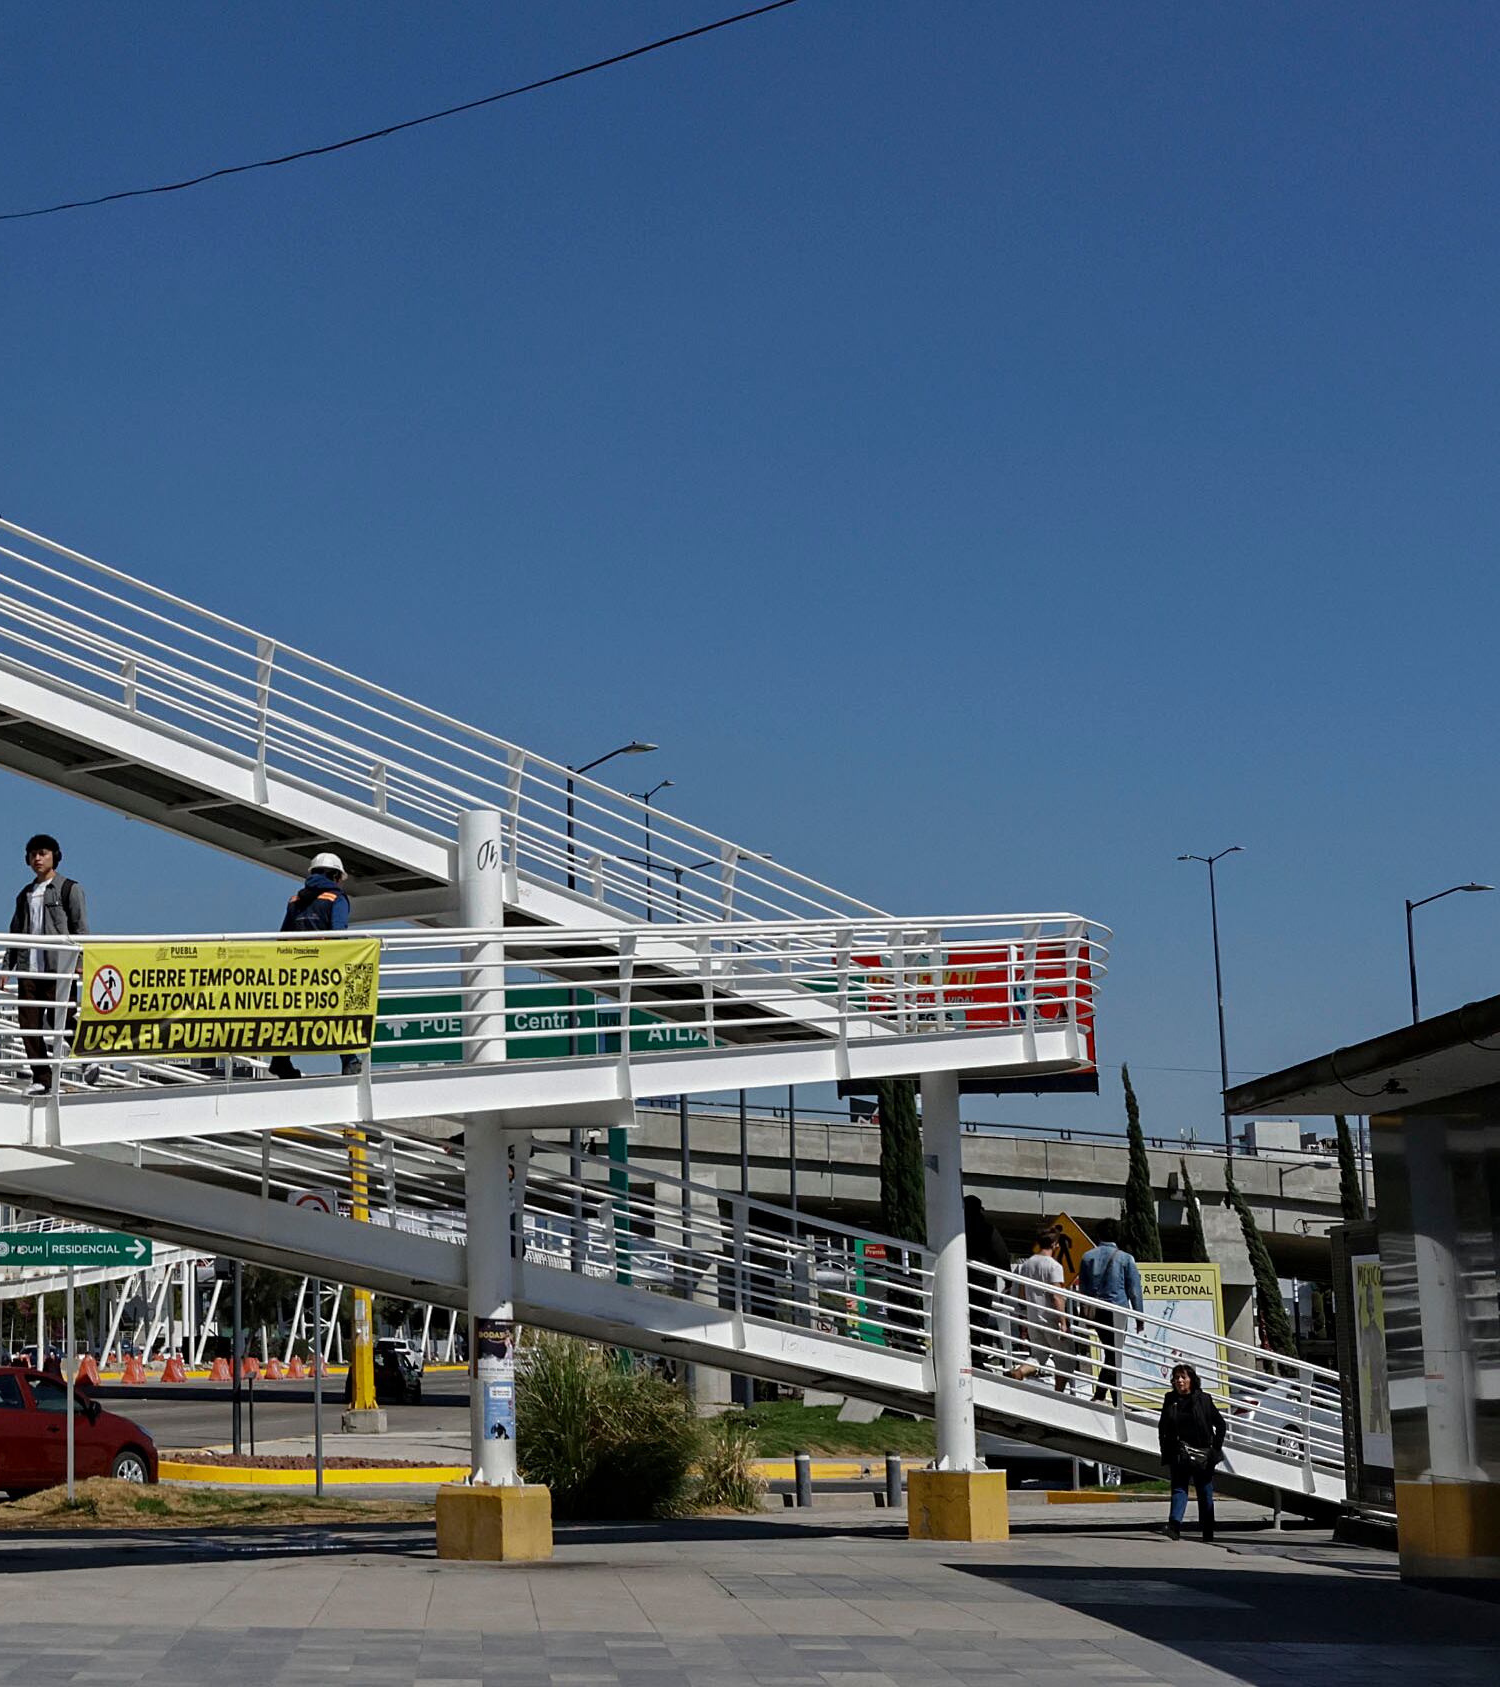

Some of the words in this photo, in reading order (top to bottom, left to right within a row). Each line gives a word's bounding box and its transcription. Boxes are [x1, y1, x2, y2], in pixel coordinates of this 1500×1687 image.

[170, 946, 197, 955] PUEBLA
[129, 967, 187, 988] CIERRE
[190, 968, 275, 987] TEMPORAL
[279, 968, 298, 985] DE
[300, 968, 342, 986] PASO
[128, 992, 216, 1012] PEATONAL
[219, 993, 230, 1010] A
[235, 991, 279, 1010] NIVEL
[285, 992, 303, 1009] DE
[305, 991, 339, 1009] PISO
[420, 1018, 462, 1033] PUE
[648, 1021, 708, 1042] ATLIX
[84, 1025, 133, 1050] USA
[138, 1024, 165, 1049] EL
[169, 1022, 257, 1049] PUENTE
[257, 1020, 368, 1047] PEATONAL
[51, 1245, 120, 1255] RESIDENCIAL
[1145, 1274, 1201, 1283] SEGURIDAD
[1154, 1286, 1213, 1296] PEATONAL
